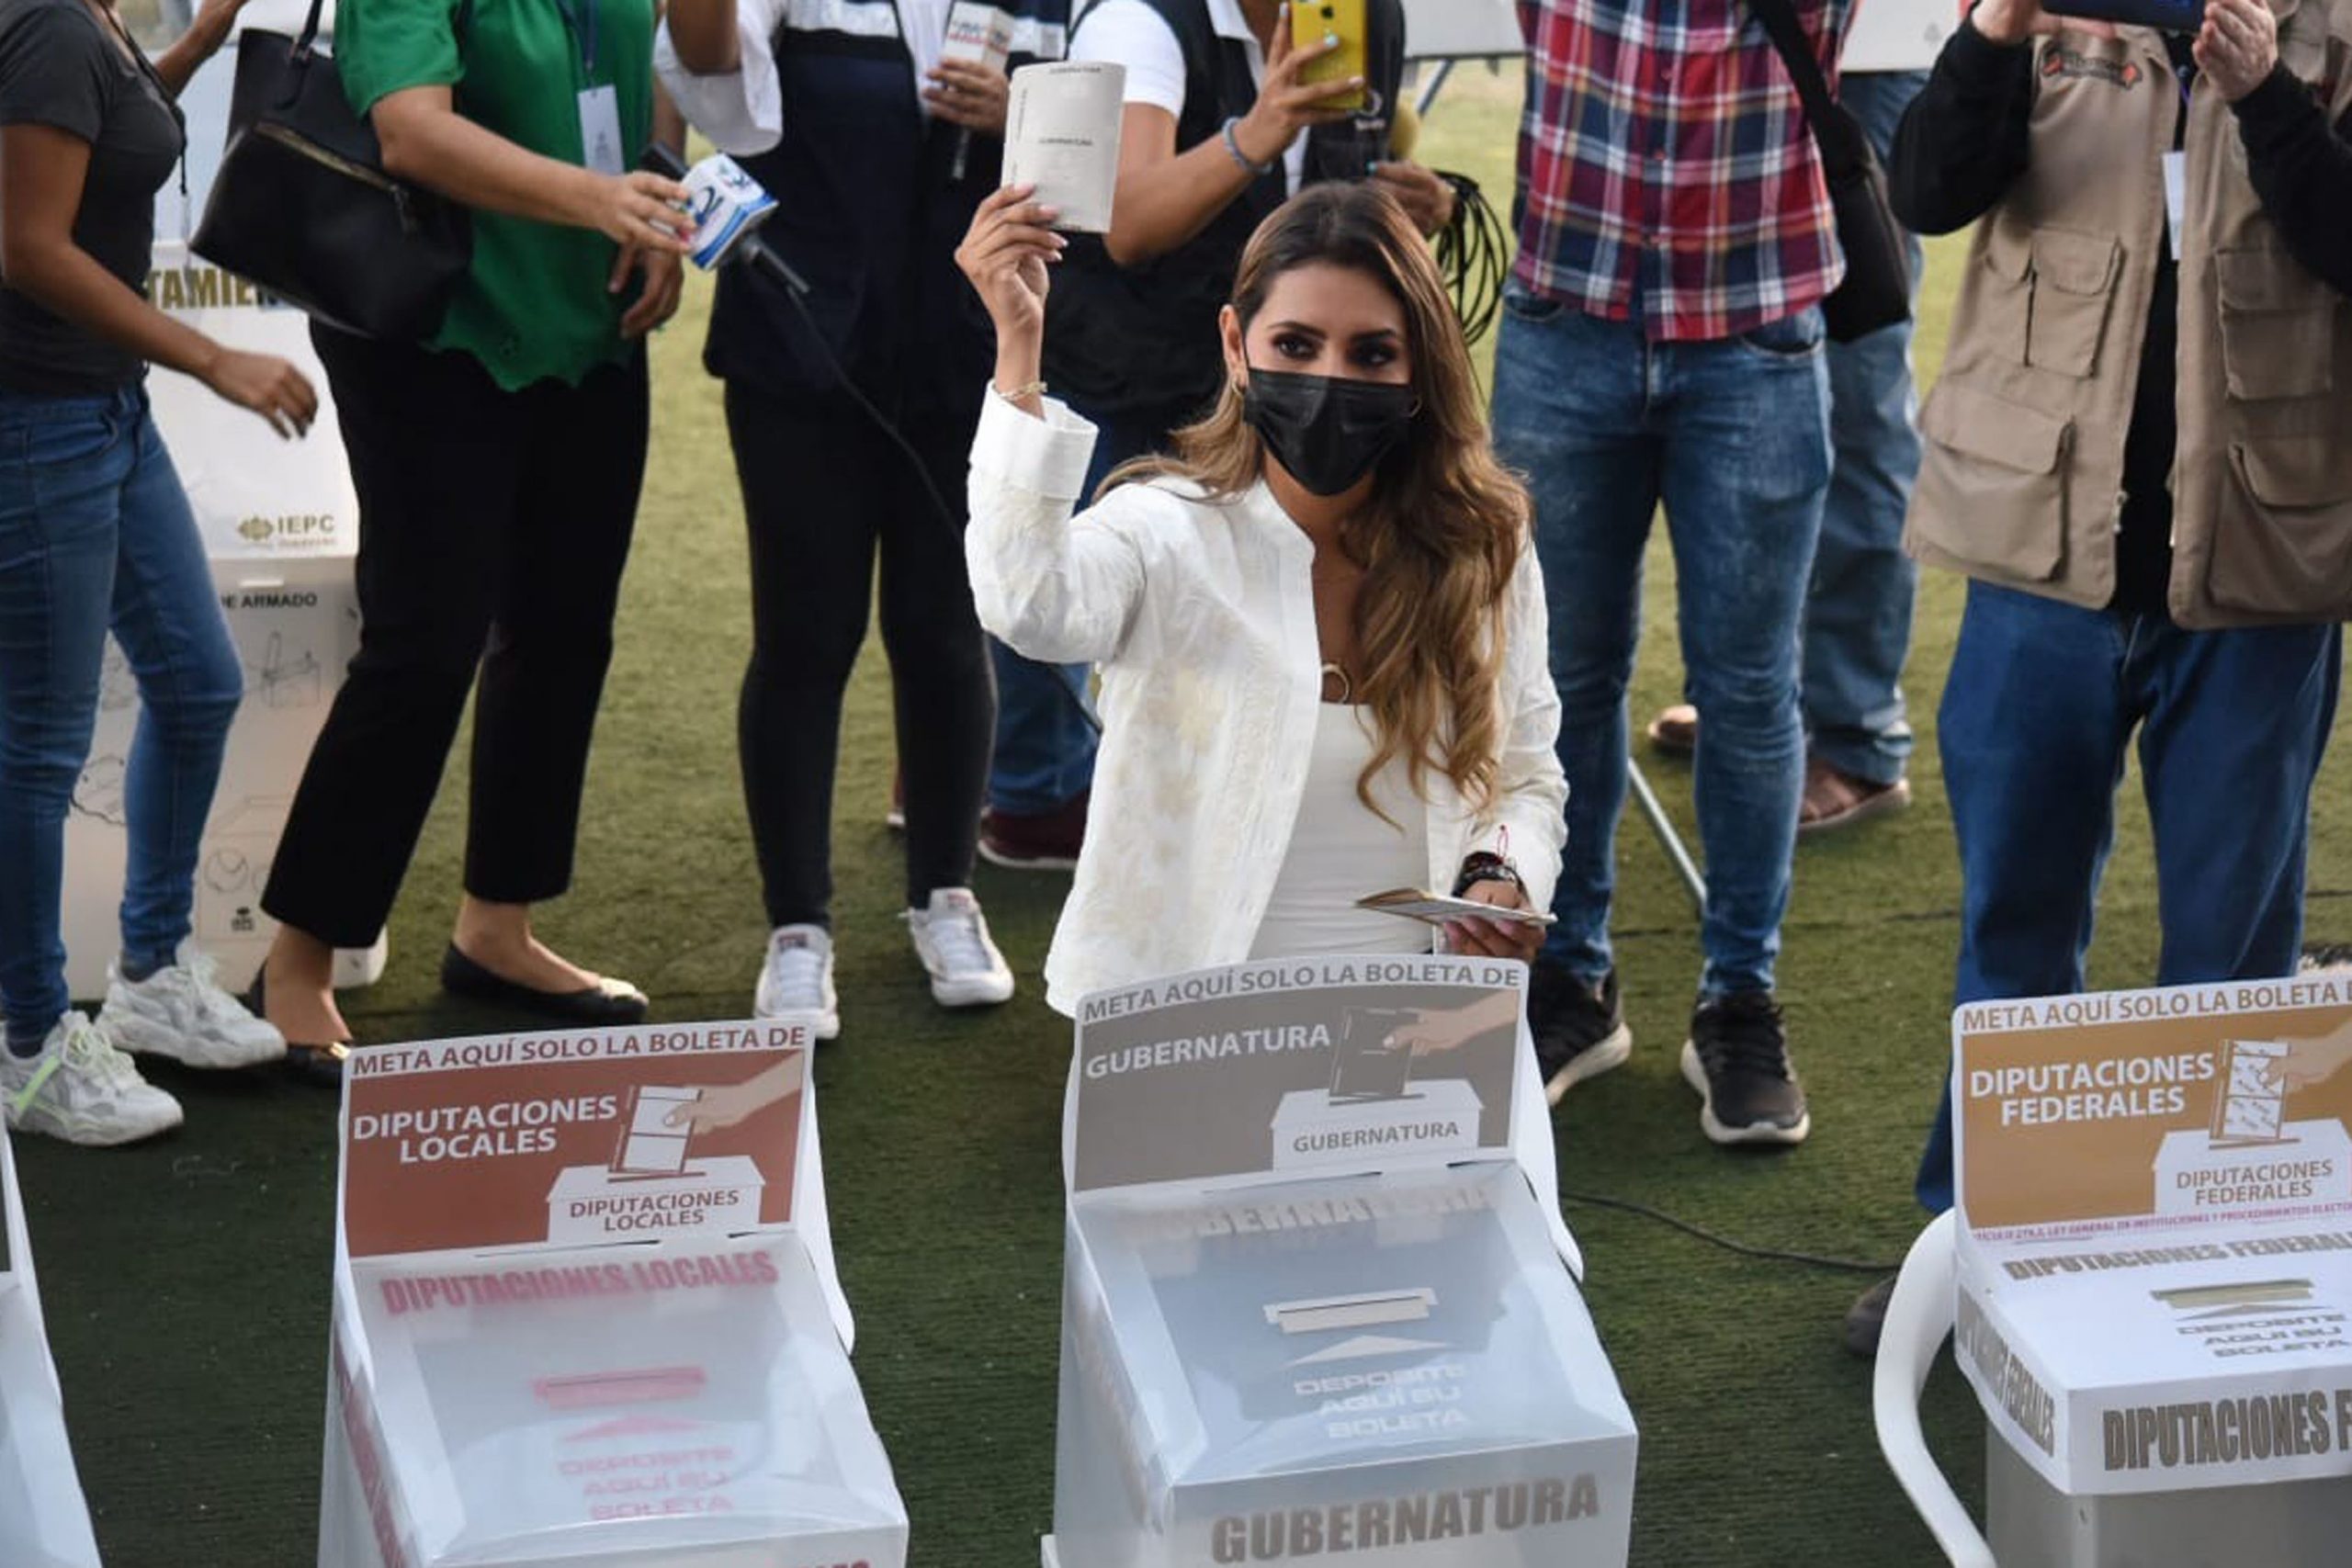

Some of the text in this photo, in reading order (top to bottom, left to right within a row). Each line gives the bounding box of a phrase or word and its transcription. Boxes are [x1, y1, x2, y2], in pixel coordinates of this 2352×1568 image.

[277, 514, 335, 535] IEPC
[241, 592, 318, 608] ARMADO
[1083, 963, 1521, 1021] META AQUÍ SOLO LA BOLETA DE
[1962, 1007, 2037, 1032] META
[2044, 999, 2111, 1029] AQUÍ
[2119, 994, 2190, 1020] SOLO
[2199, 991, 2230, 1012] LA
[2237, 981, 2340, 1010] BOLETA
[353, 1026, 807, 1076] META AQUÍ SOLO LA BOLETA DE
[1085, 1022, 1331, 1079] GUBERNATURA
[1970, 1053, 2215, 1096] DIPUTACIONES
[353, 1094, 618, 1142] DIPUTACIONES
[2001, 1086, 2186, 1126] FEDERALES
[400, 1129, 558, 1165] LOCALES
[1293, 1122, 1460, 1154] GUBERNATURA
[2177, 1159, 2334, 1190] DIPUTACIONES
[2195, 1180, 2313, 1206] FEDERALES
[569, 1190, 741, 1220] DIPUTACIONES
[604, 1208, 706, 1233] LOCALES
[2002, 1244, 2230, 1280] DIPUTACIONES
[381, 1250, 779, 1315] DIPUTACIONES LOCALES
[2103, 1390, 2331, 1472] DIPUTACIONES
[1212, 1471, 1600, 1565] GUBERNATURA
